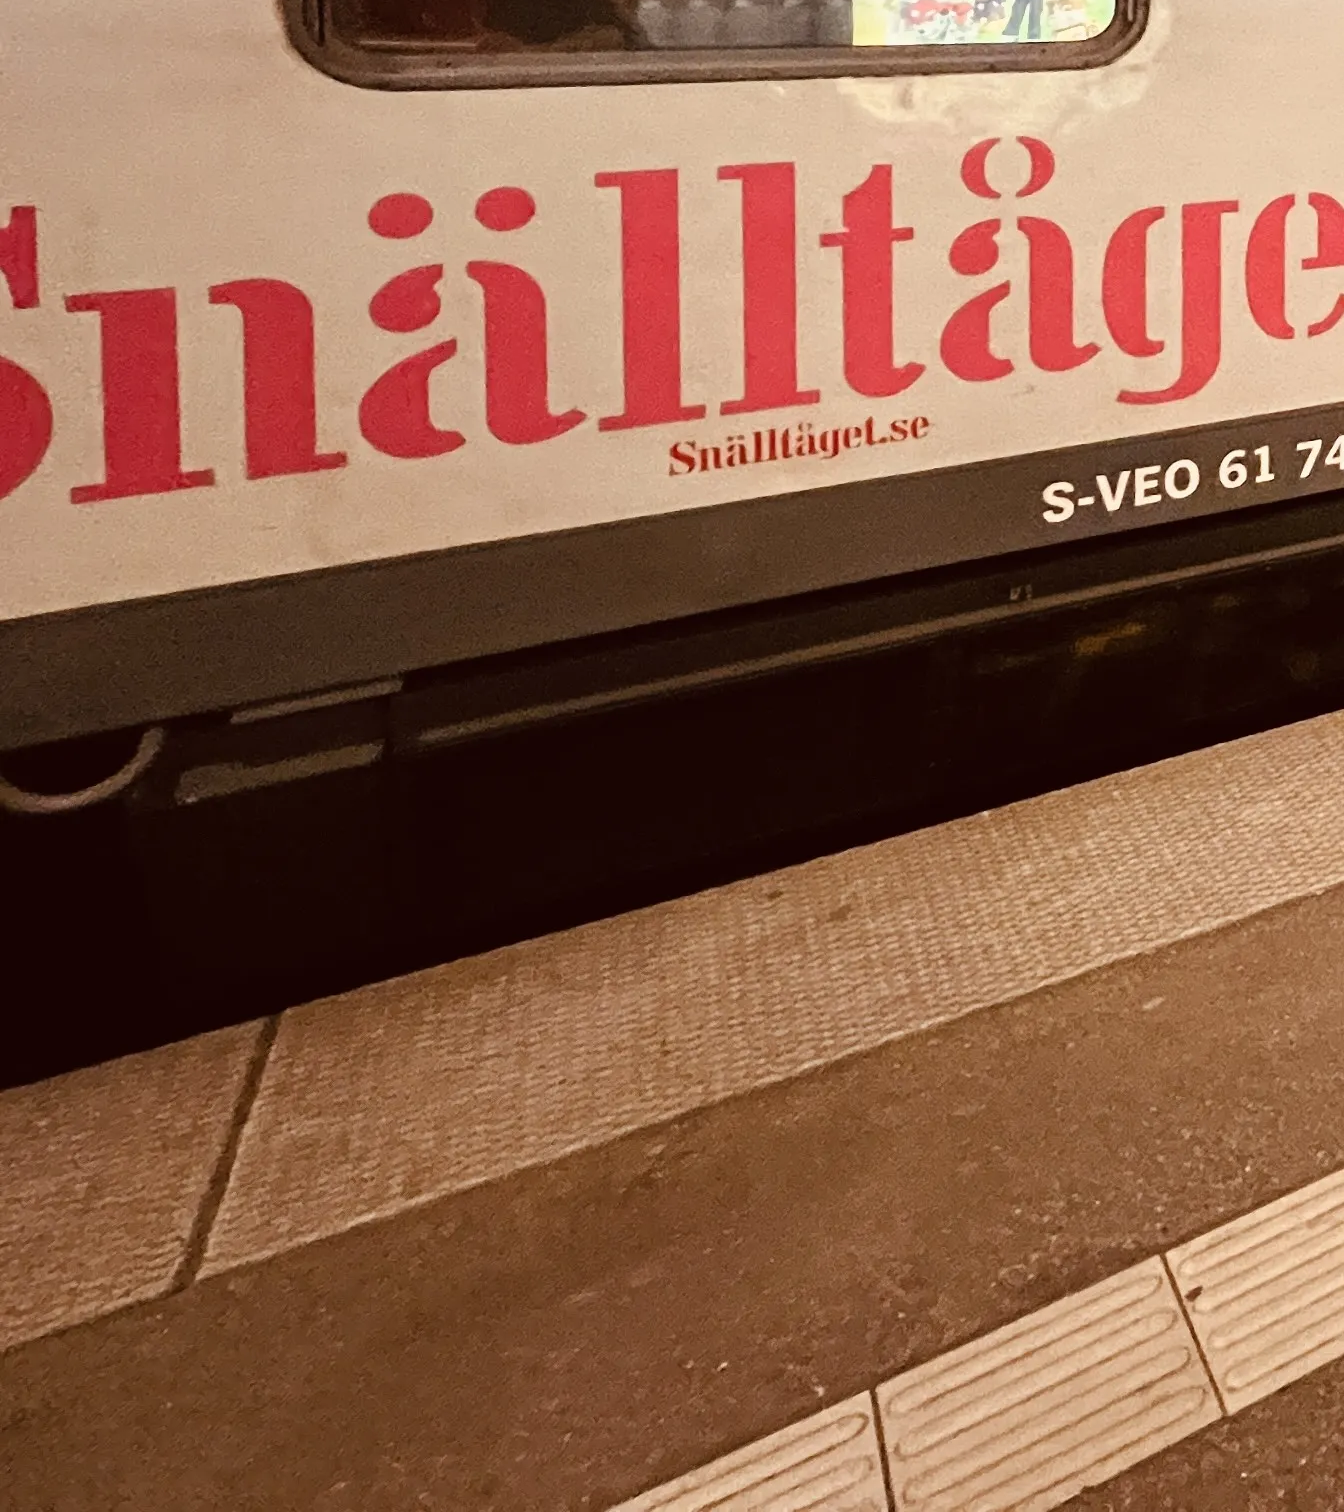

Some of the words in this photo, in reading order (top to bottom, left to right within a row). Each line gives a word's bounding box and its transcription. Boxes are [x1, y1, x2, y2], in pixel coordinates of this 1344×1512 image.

[668, 415, 931, 477] Snälltåget.se
[1041, 458, 1201, 524] S-VEO
[1218, 445, 1276, 490] 61
